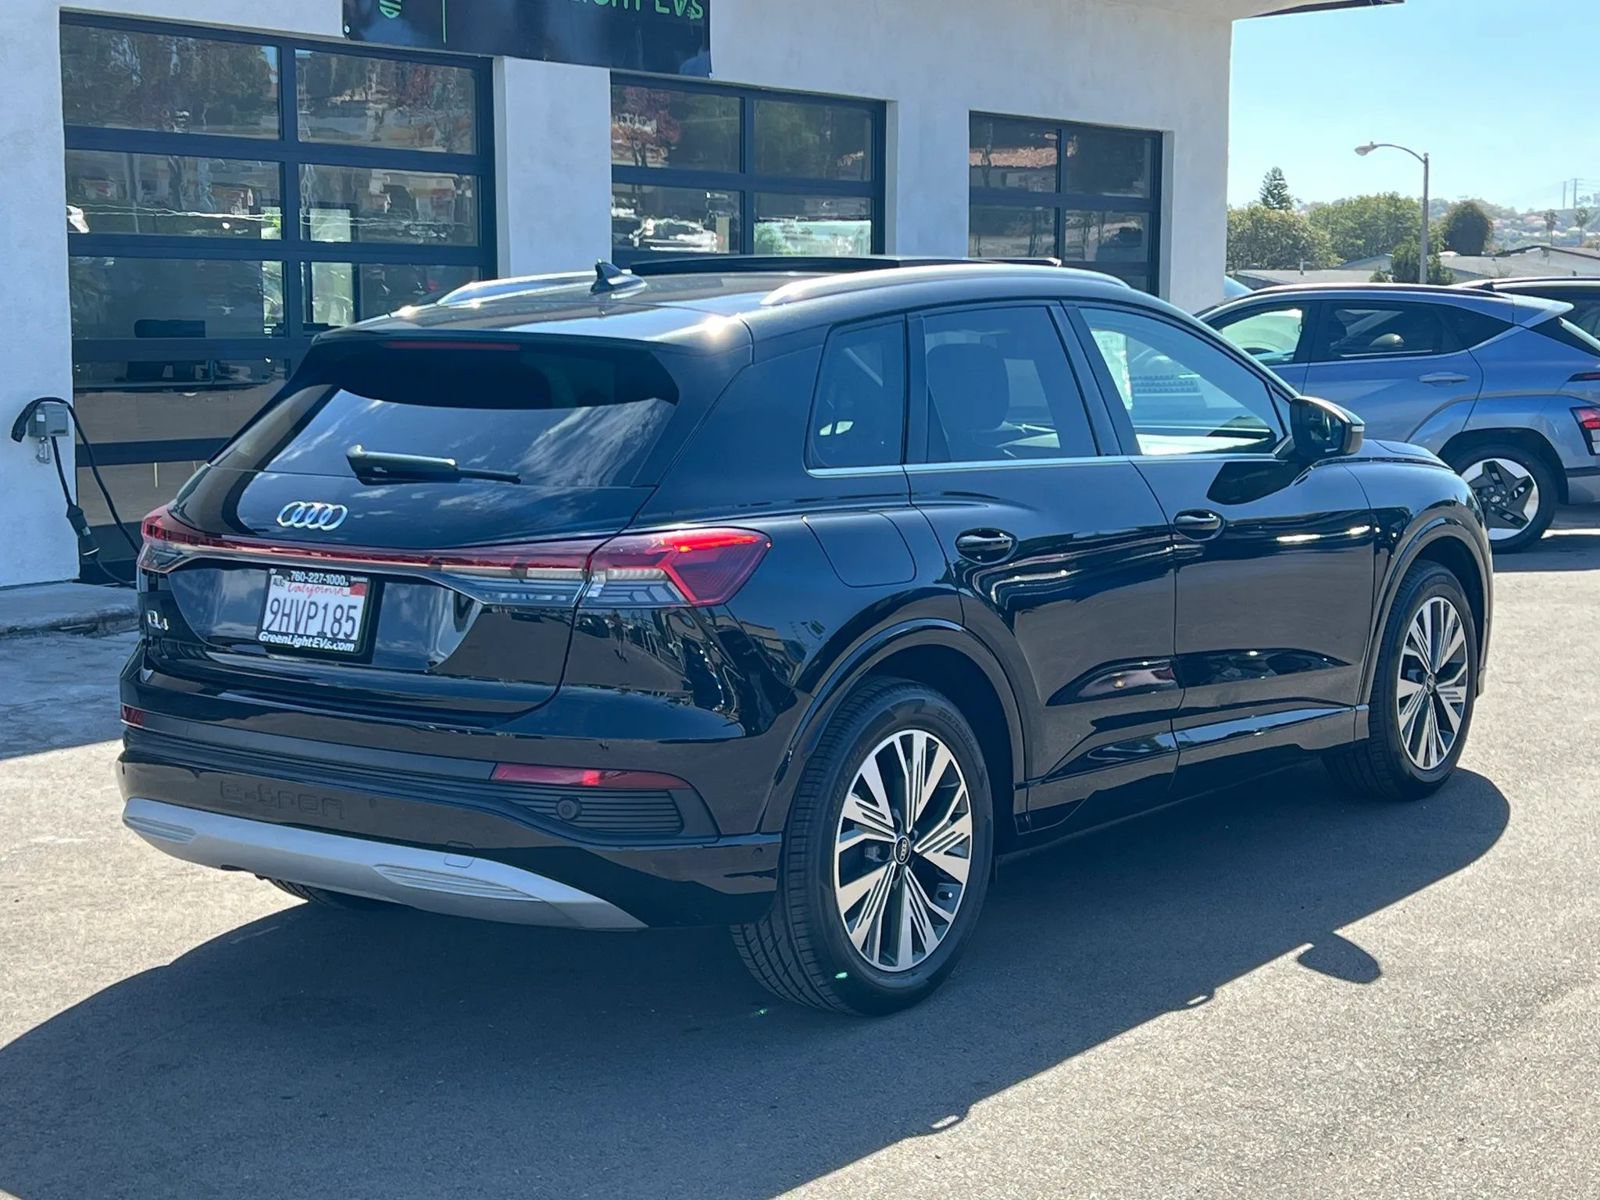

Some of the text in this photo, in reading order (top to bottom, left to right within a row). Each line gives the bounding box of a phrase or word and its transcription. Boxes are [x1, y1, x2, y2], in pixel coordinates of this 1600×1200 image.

[290, 570, 346, 586] 760-227-1000
[267, 598, 358, 639] 9HVP185
[258, 631, 355, 652] GreenLightEVs.com
[219, 780, 345, 820] e-tron
